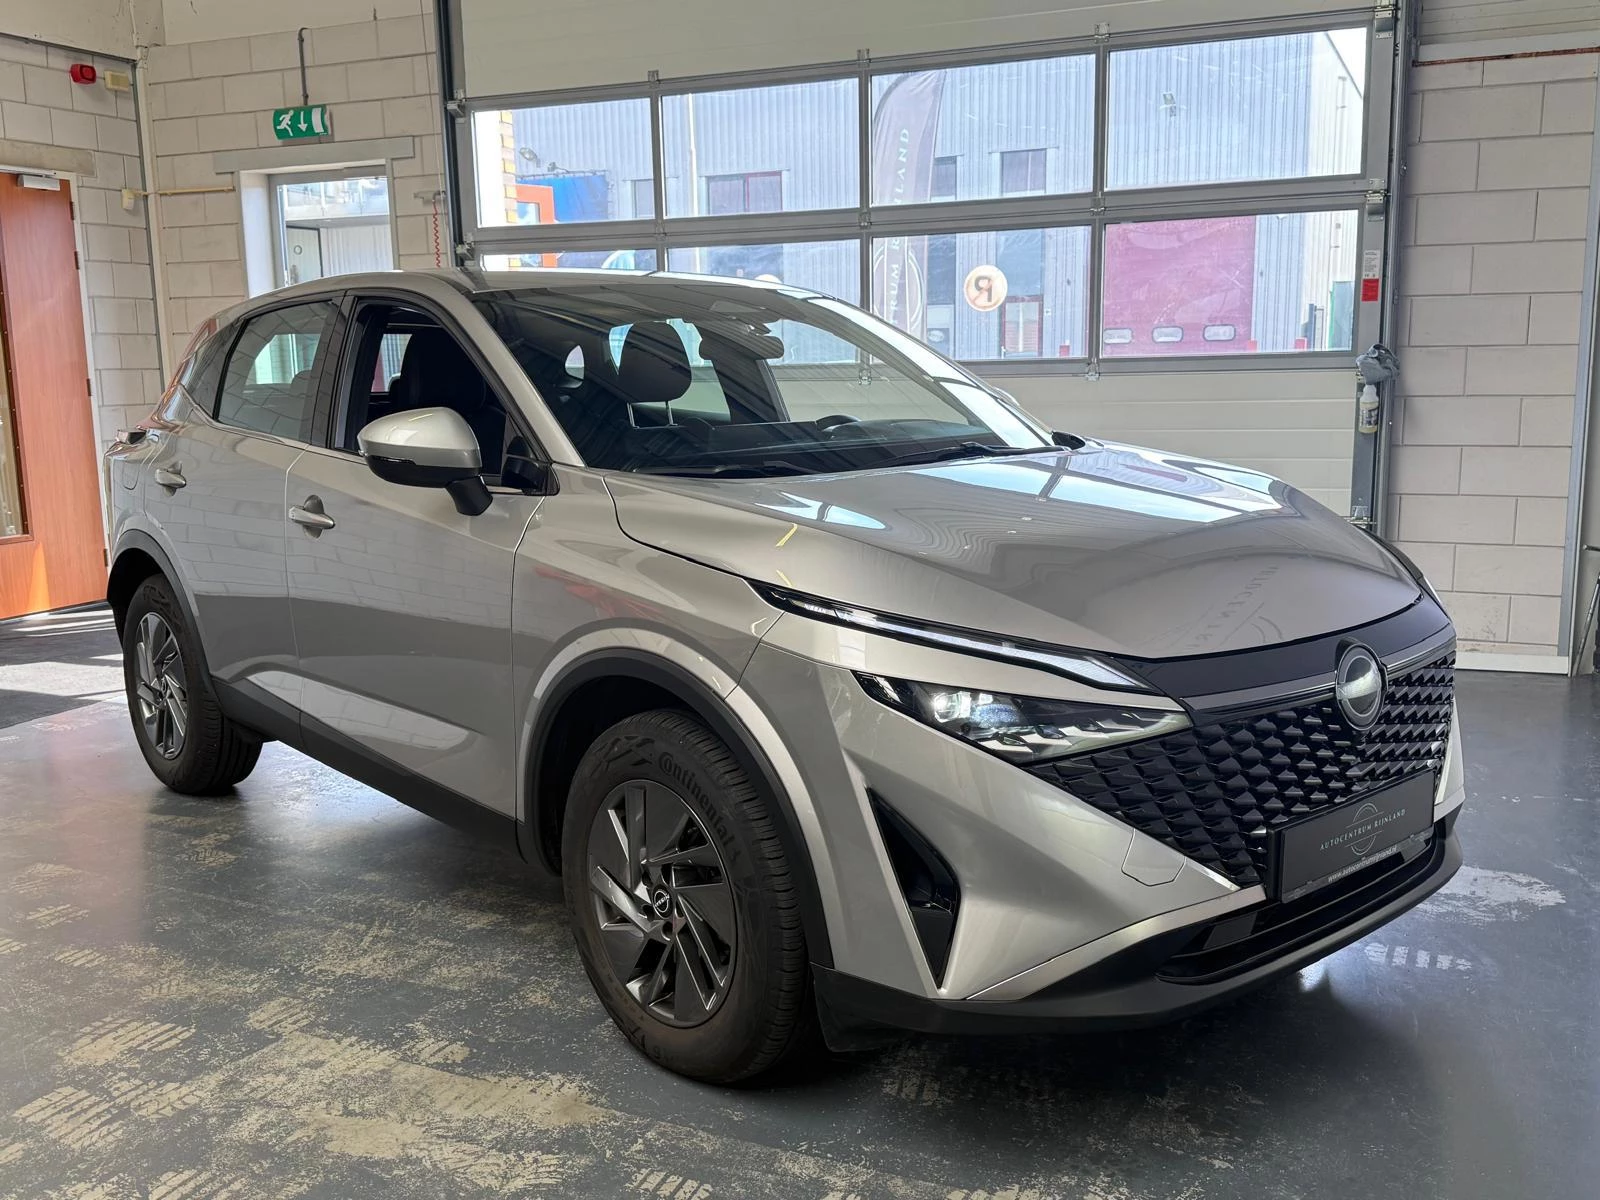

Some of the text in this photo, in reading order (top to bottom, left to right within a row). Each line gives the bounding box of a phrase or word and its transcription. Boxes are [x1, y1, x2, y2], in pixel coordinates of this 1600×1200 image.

[659, 752, 735, 846] Continental
[1320, 808, 1406, 850] AUTOCENTRUM RIJNLAND
